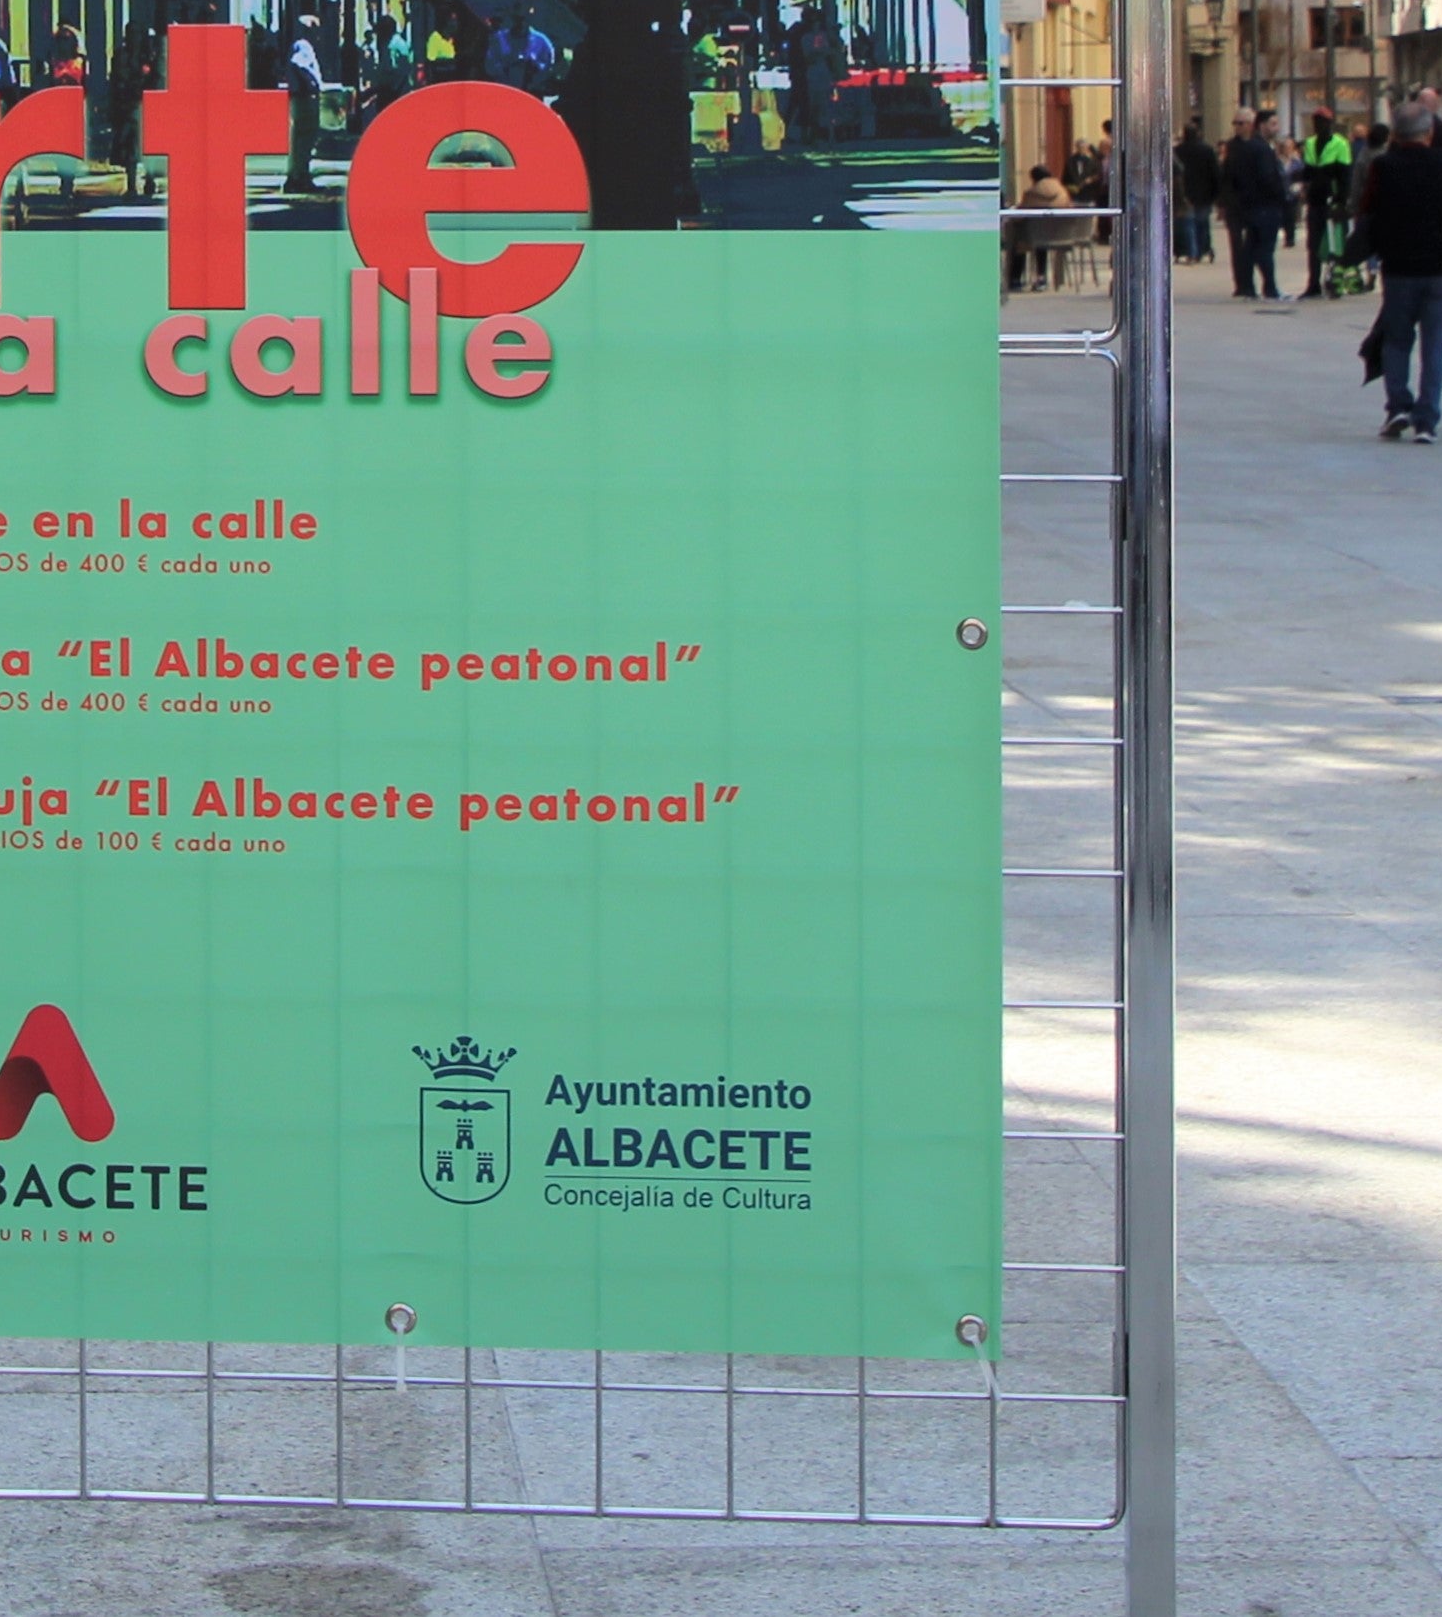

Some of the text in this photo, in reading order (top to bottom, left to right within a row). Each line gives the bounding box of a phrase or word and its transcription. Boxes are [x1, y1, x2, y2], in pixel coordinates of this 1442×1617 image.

[145, 267, 553, 398] calle
[32, 511, 94, 539] en
[119, 497, 167, 540] la
[191, 498, 318, 541] calle
[40, 551, 69, 573] de
[79, 553, 125, 573] 400
[137, 553, 148, 573] €
[160, 552, 218, 574] cada
[229, 560, 272, 575] uno
[154, 637, 396, 680] Albacete
[40, 690, 69, 712] de
[79, 692, 126, 712] 400
[138, 692, 149, 712] €
[160, 691, 219, 713] cada
[229, 699, 272, 714] uno
[191, 776, 434, 820] Albacete
[55, 829, 84, 851] de
[97, 831, 139, 851] 100
[151, 831, 162, 851] €
[174, 831, 232, 853] cada
[243, 839, 286, 853] uno
[544, 1073, 812, 1115] Ayuntamiento
[544, 1126, 812, 1172] ALBACETE
[543, 1182, 812, 1213] Concejalía de Cultura
